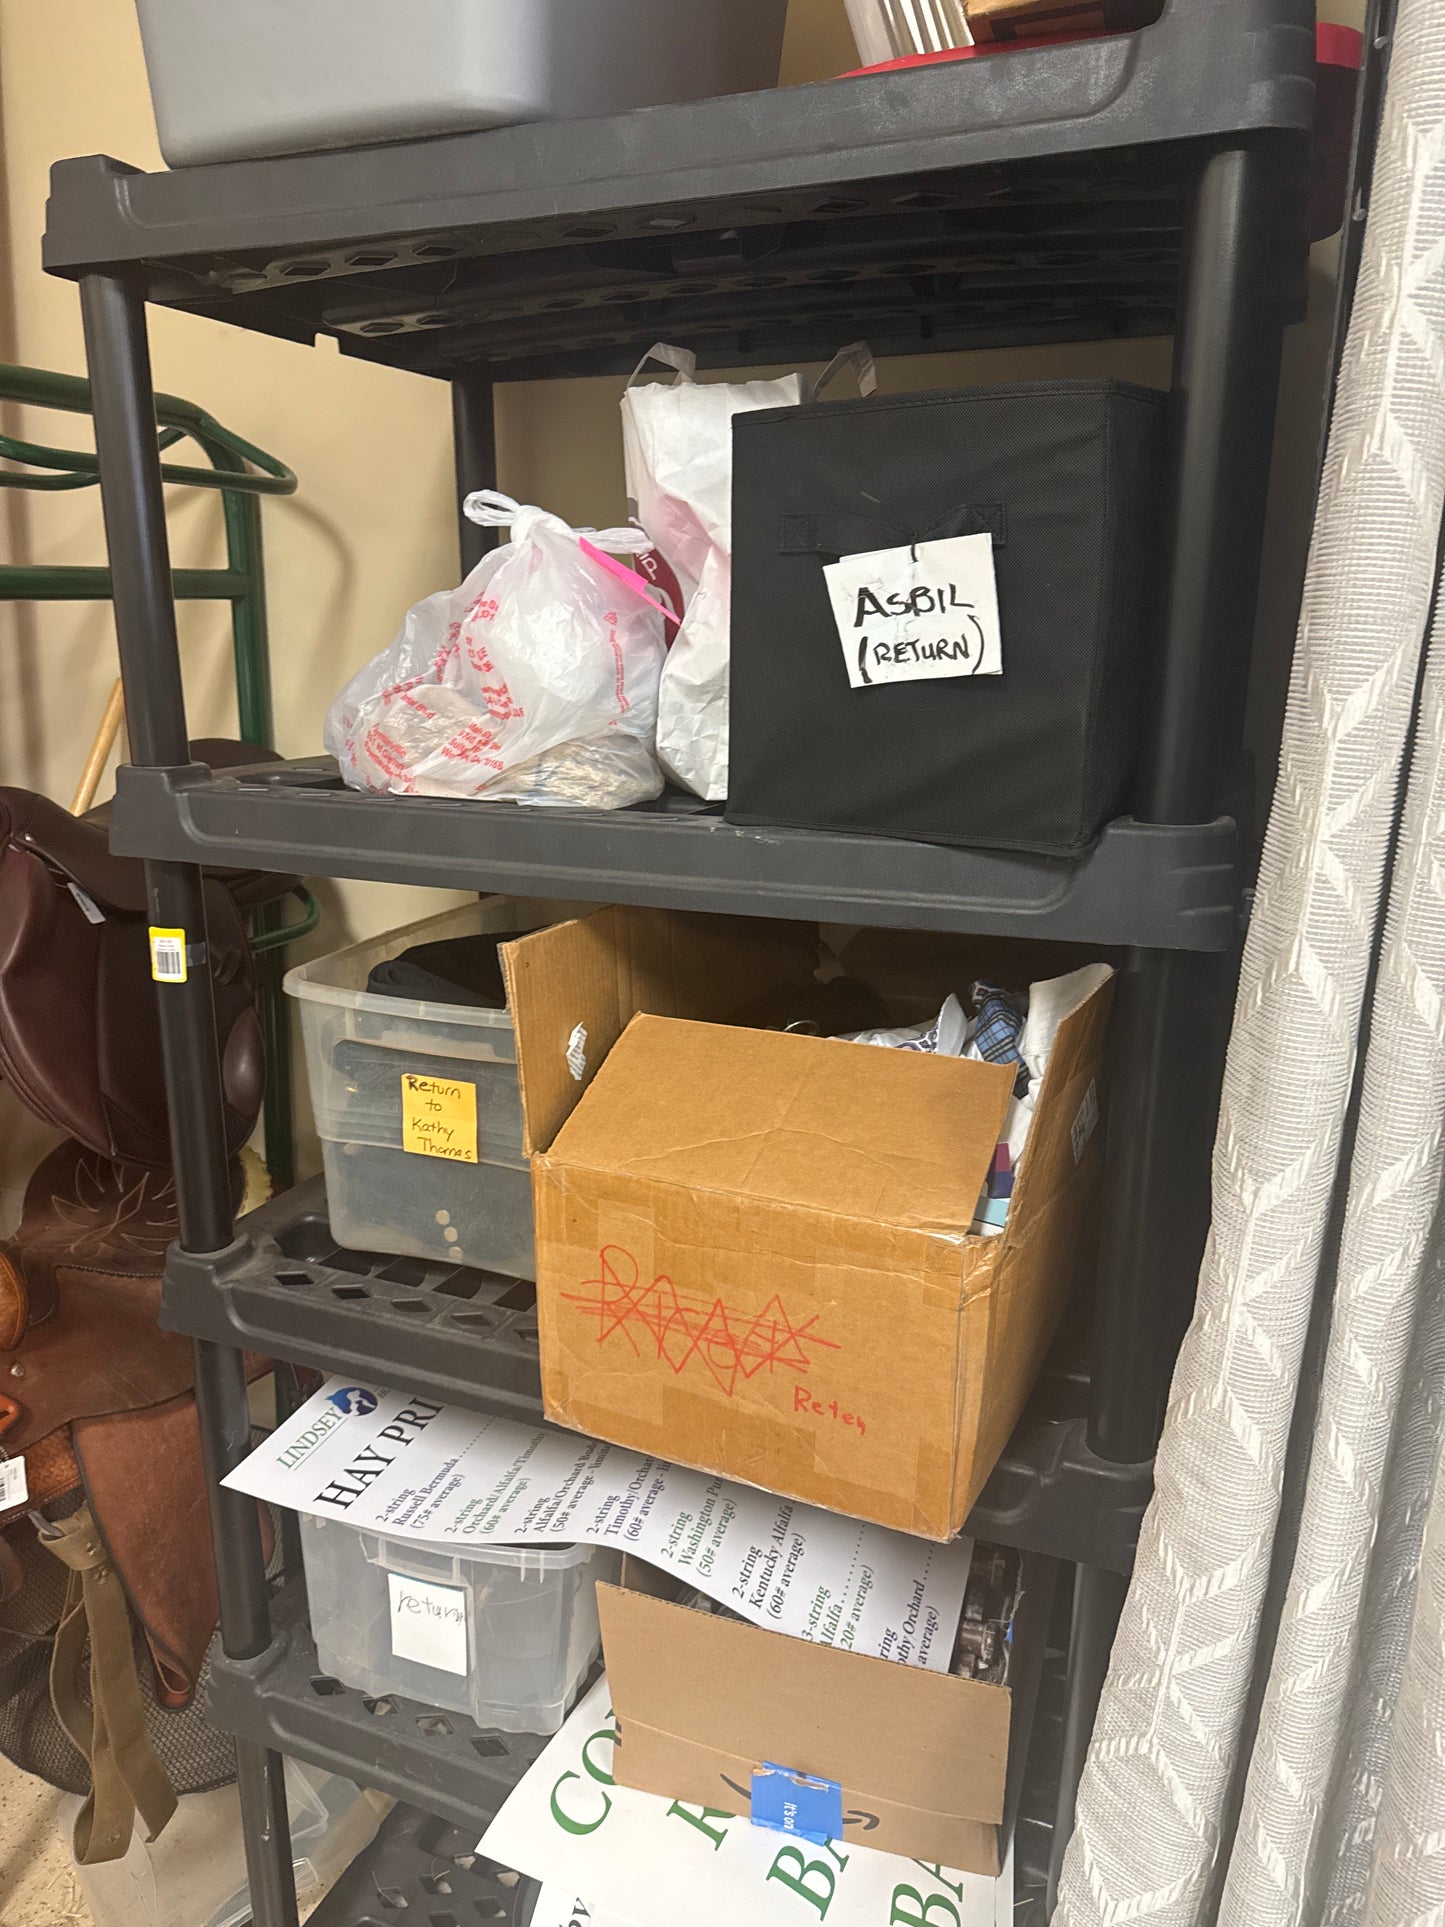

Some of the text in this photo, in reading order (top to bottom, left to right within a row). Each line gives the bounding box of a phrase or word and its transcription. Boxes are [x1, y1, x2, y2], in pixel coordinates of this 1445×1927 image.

[854, 583, 975, 628] ASBIL
[858, 615, 985, 684] (RETURN)
[406, 1075, 461, 1099] Return
[425, 1099, 442, 1112] to
[412, 1117, 454, 1141] Kathy
[417, 1137, 472, 1159] Thomas
[276, 1408, 347, 1469] LINDSEY
[314, 1397, 443, 1510] HAY PRI
[376, 1489, 416, 1521] 2-string
[392, 1459, 459, 1525] Russell Bermuda
[431, 1474, 466, 1508] average)
[444, 1499, 483, 1533] 2-string
[498, 1478, 532, 1512] average)
[514, 1497, 551, 1533] 2-string
[533, 1462, 586, 1532] Alfalfa/Orchard
[567, 1475, 594, 1509] average
[586, 1495, 620, 1533] 2-string
[640, 1478, 666, 1517] average
[660, 1511, 693, 1558] 2-string
[678, 1499, 716, 1565] Washington
[696, 1498, 737, 1577] (50# average)
[749, 1504, 794, 1609] Kentucky Alfalfa
[731, 1546, 764, 1599] 2-string
[766, 1532, 806, 1620] (60# average)
[851, 1564, 875, 1622] average)
[801, 1585, 831, 1641] 3-string
[902, 1579, 925, 1636] Orchard
[918, 1605, 940, 1665] average)
[550, 1707, 616, 1835] CO
[784, 1802, 797, 1817] It's
